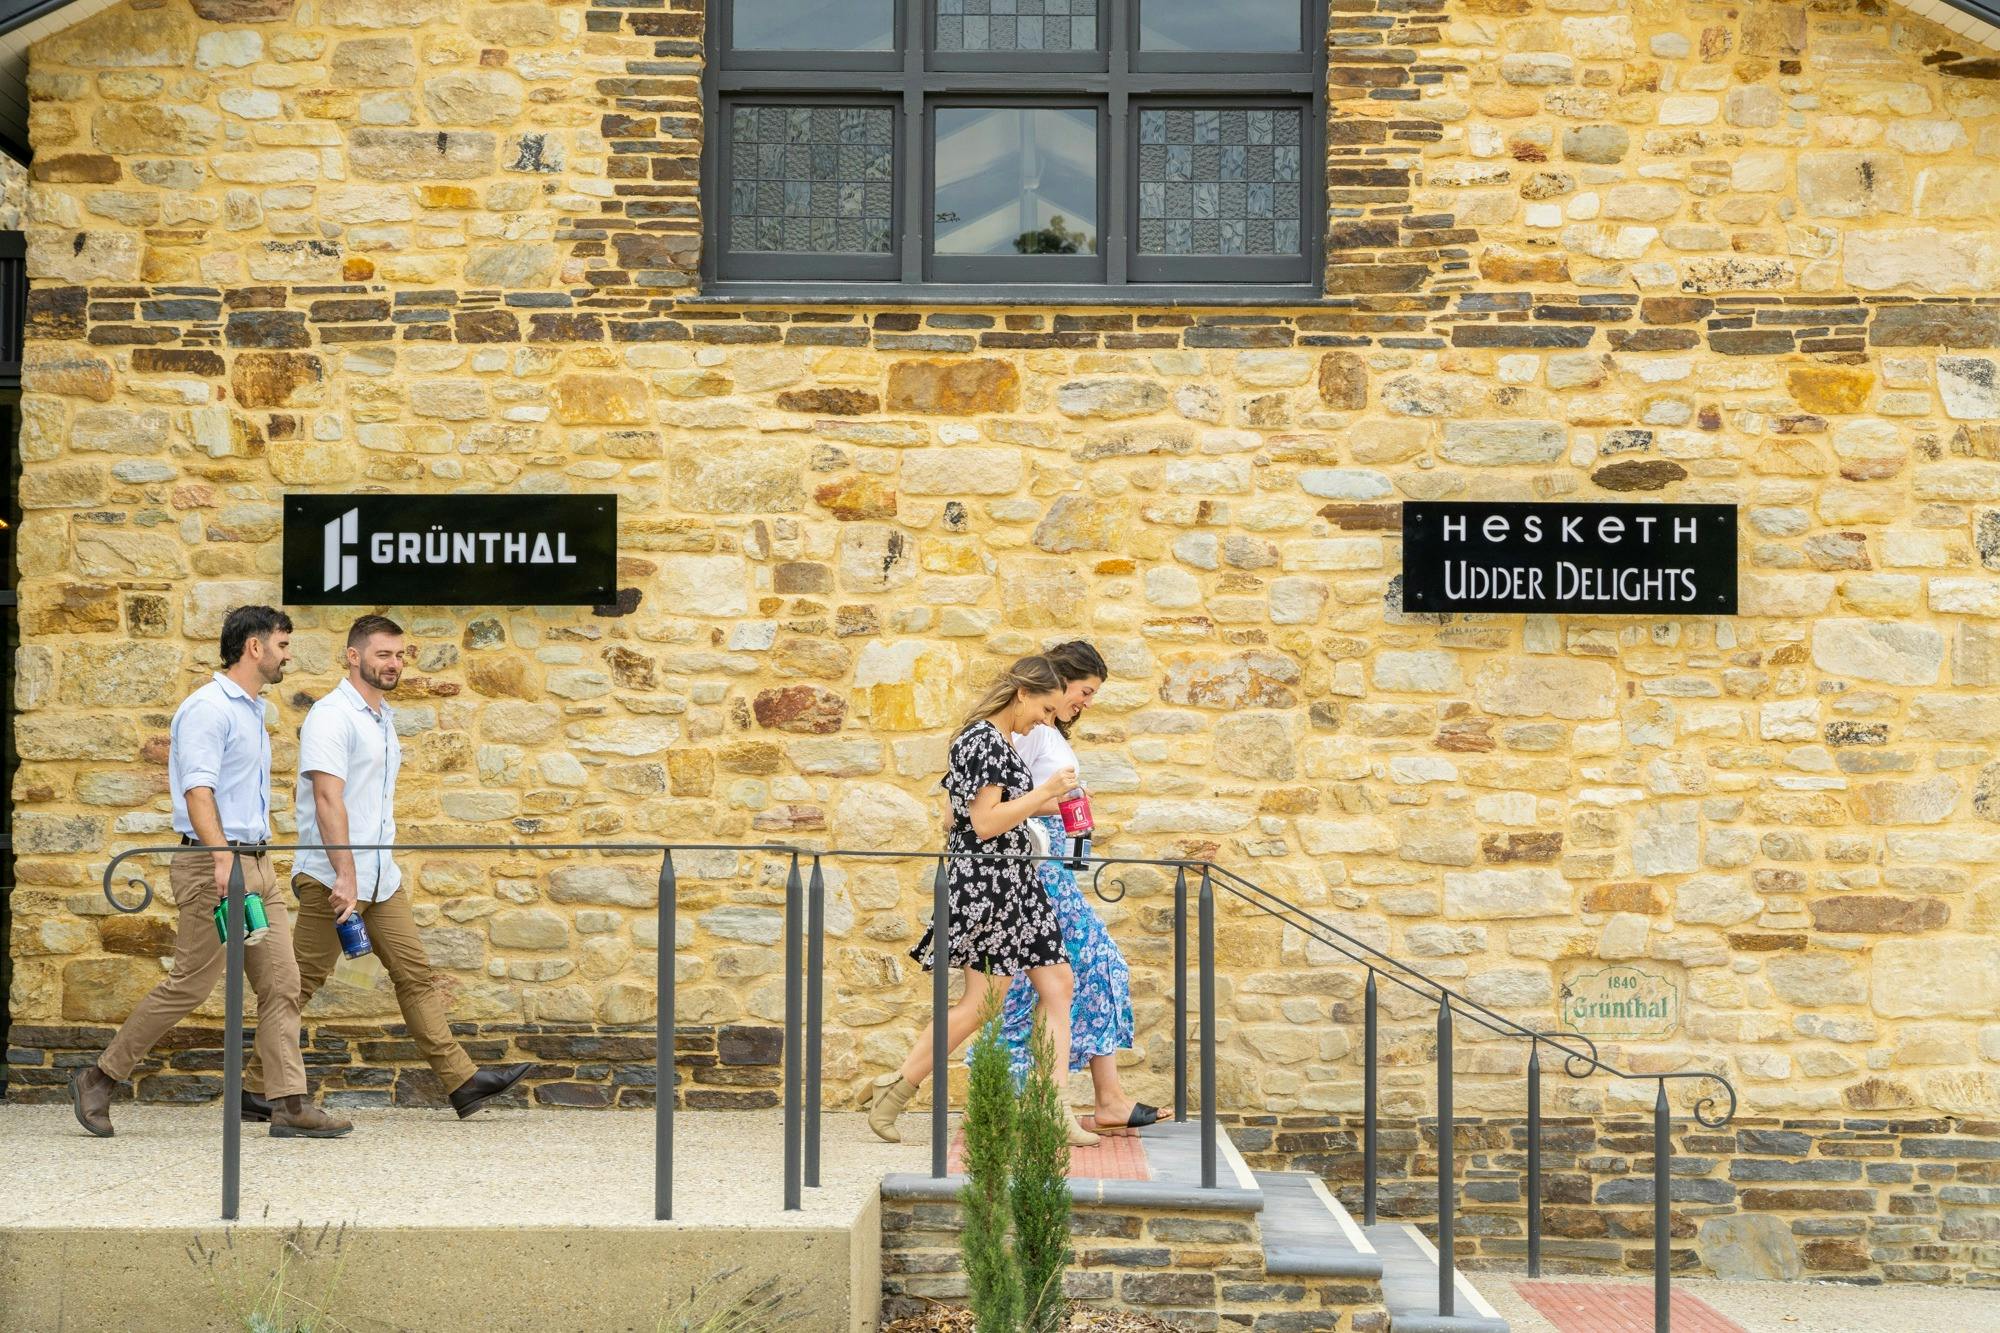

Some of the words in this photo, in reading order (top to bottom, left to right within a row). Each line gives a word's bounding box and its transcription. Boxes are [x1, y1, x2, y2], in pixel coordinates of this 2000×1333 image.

[371, 525, 577, 563] GRÜNTHAL
[1444, 560, 1545, 600] UDDER
[1556, 561, 1697, 602] DELIGHTS
[1608, 976, 1637, 989] 1840
[1573, 993, 1667, 1018] Grünthal
